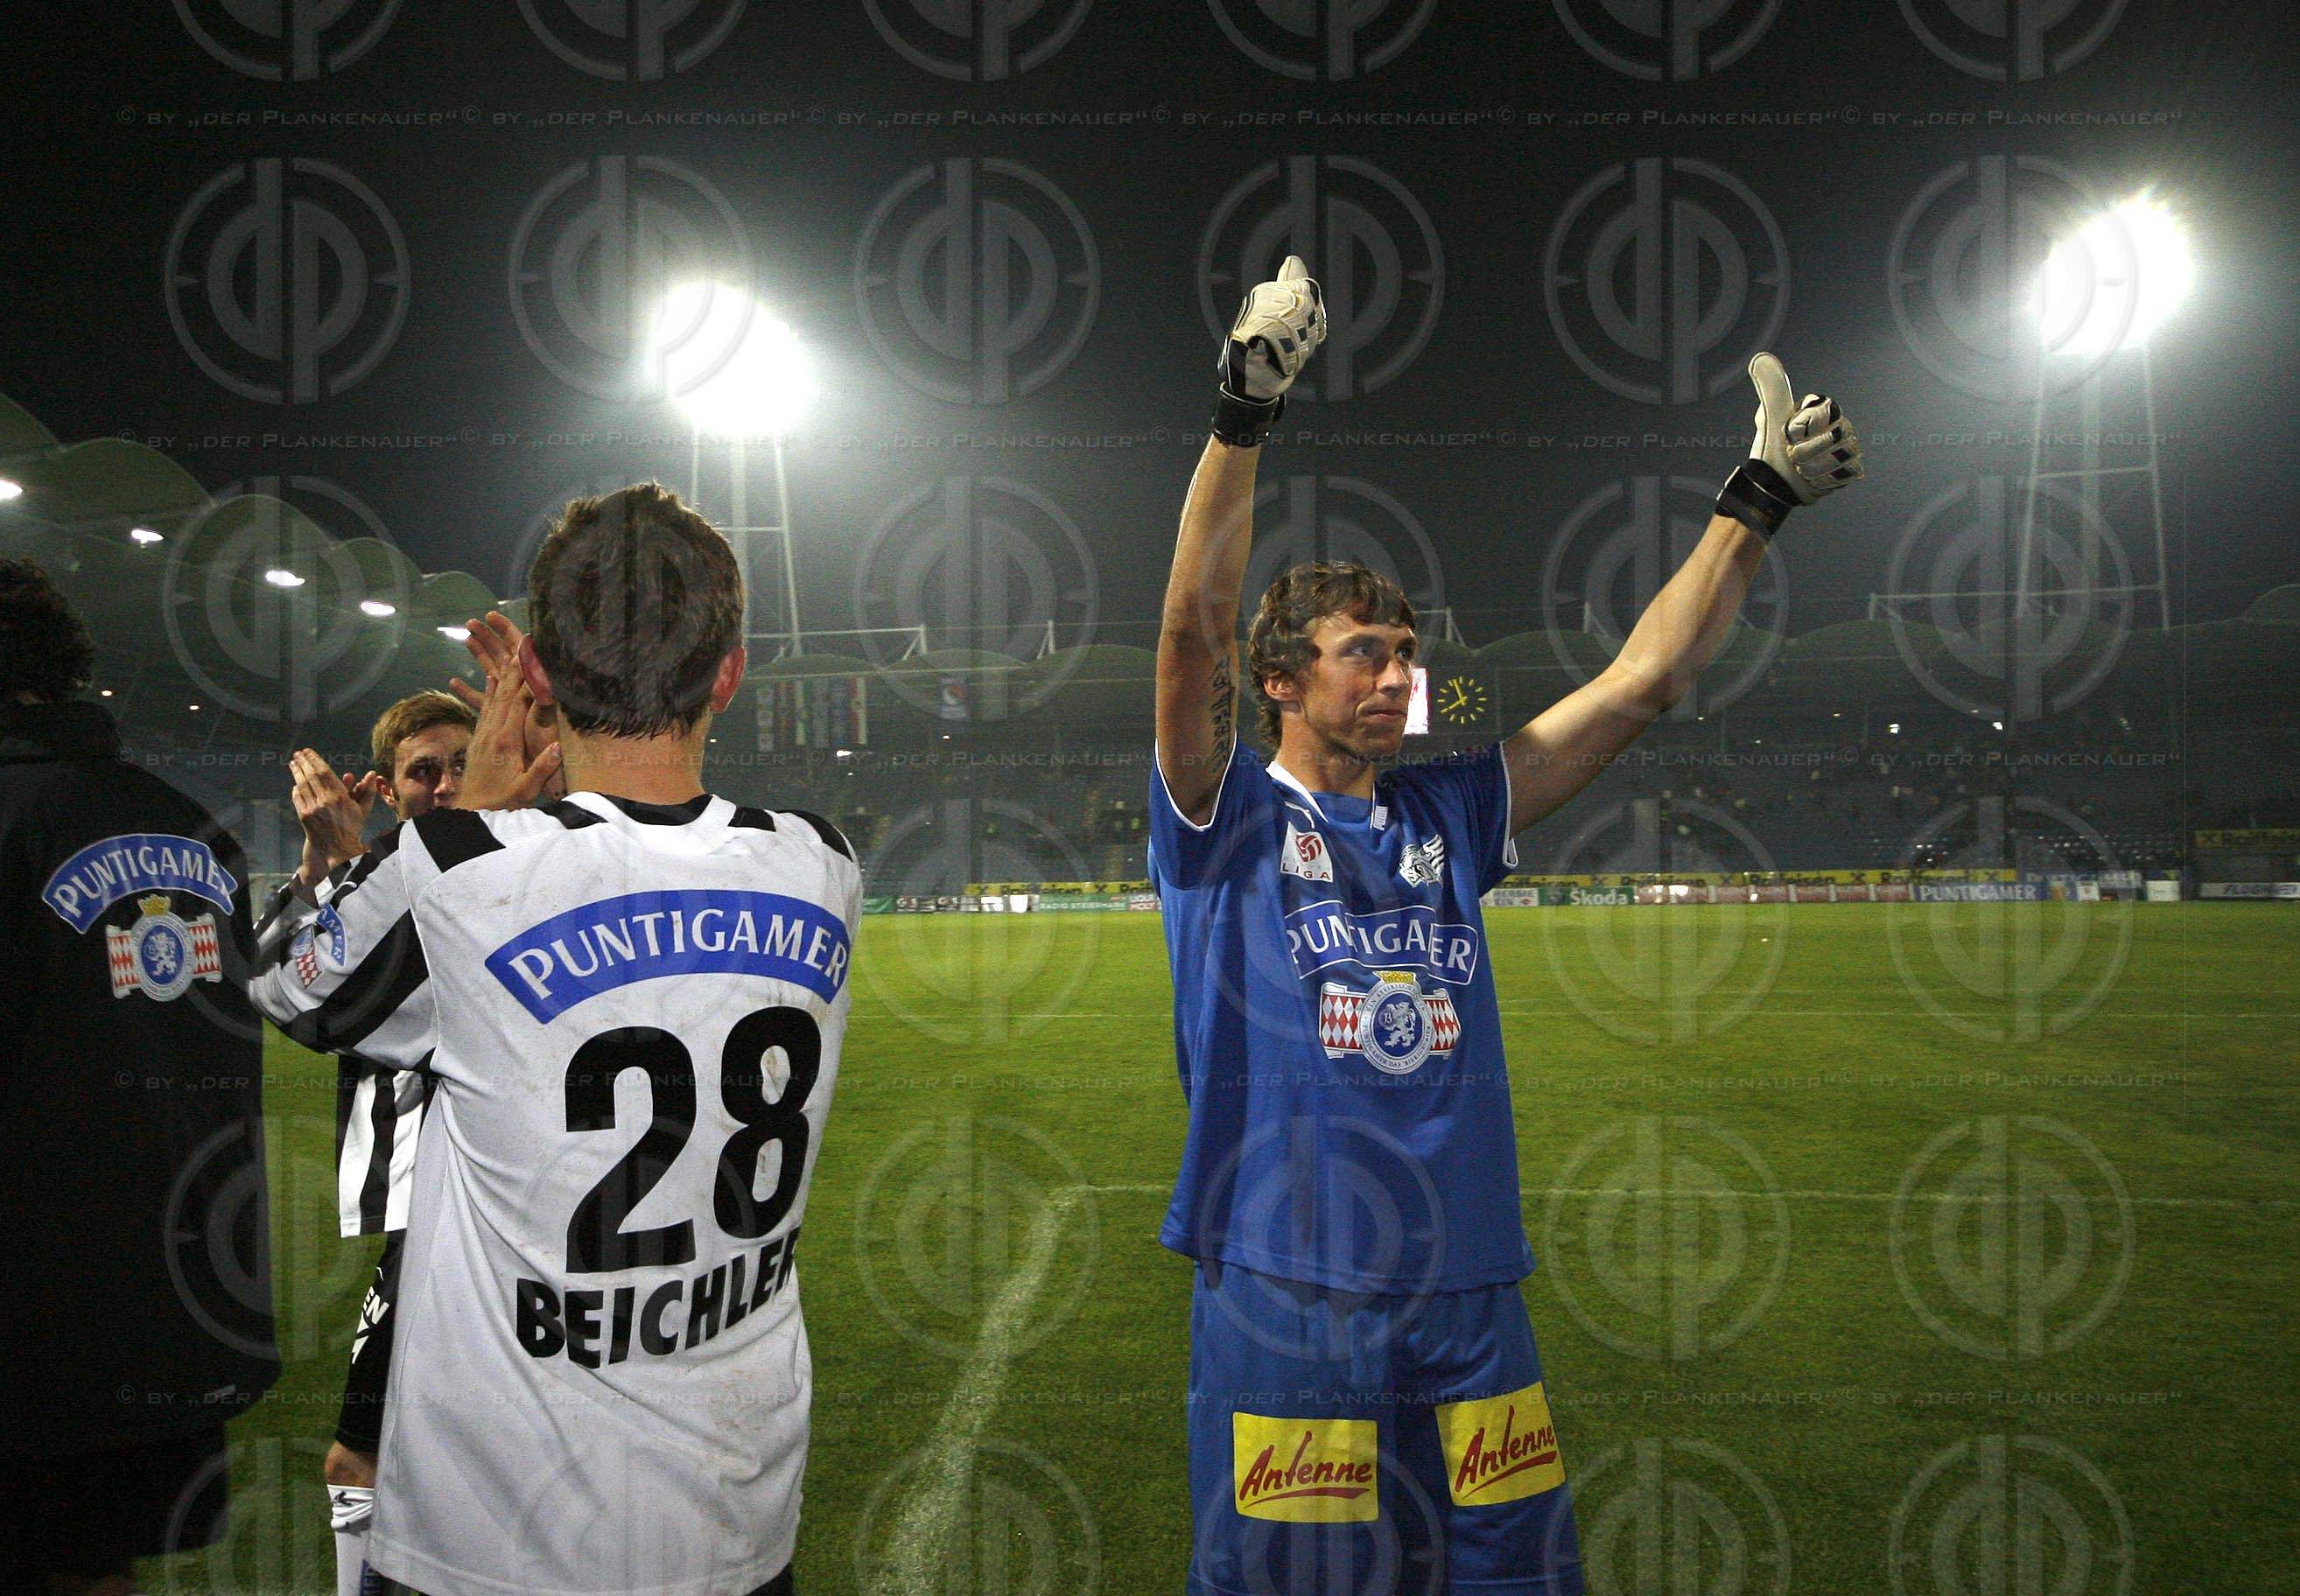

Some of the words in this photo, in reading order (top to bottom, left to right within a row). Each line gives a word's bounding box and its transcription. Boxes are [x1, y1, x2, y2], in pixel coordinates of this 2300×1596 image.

[1281, 862, 1331, 881] LIGA
[508, 908, 848, 1000] PUNTIGAMER
[564, 1005, 822, 1273] 28
[1239, 1431, 1373, 1501] Antenne
[1455, 1404, 1556, 1492] Antenne
